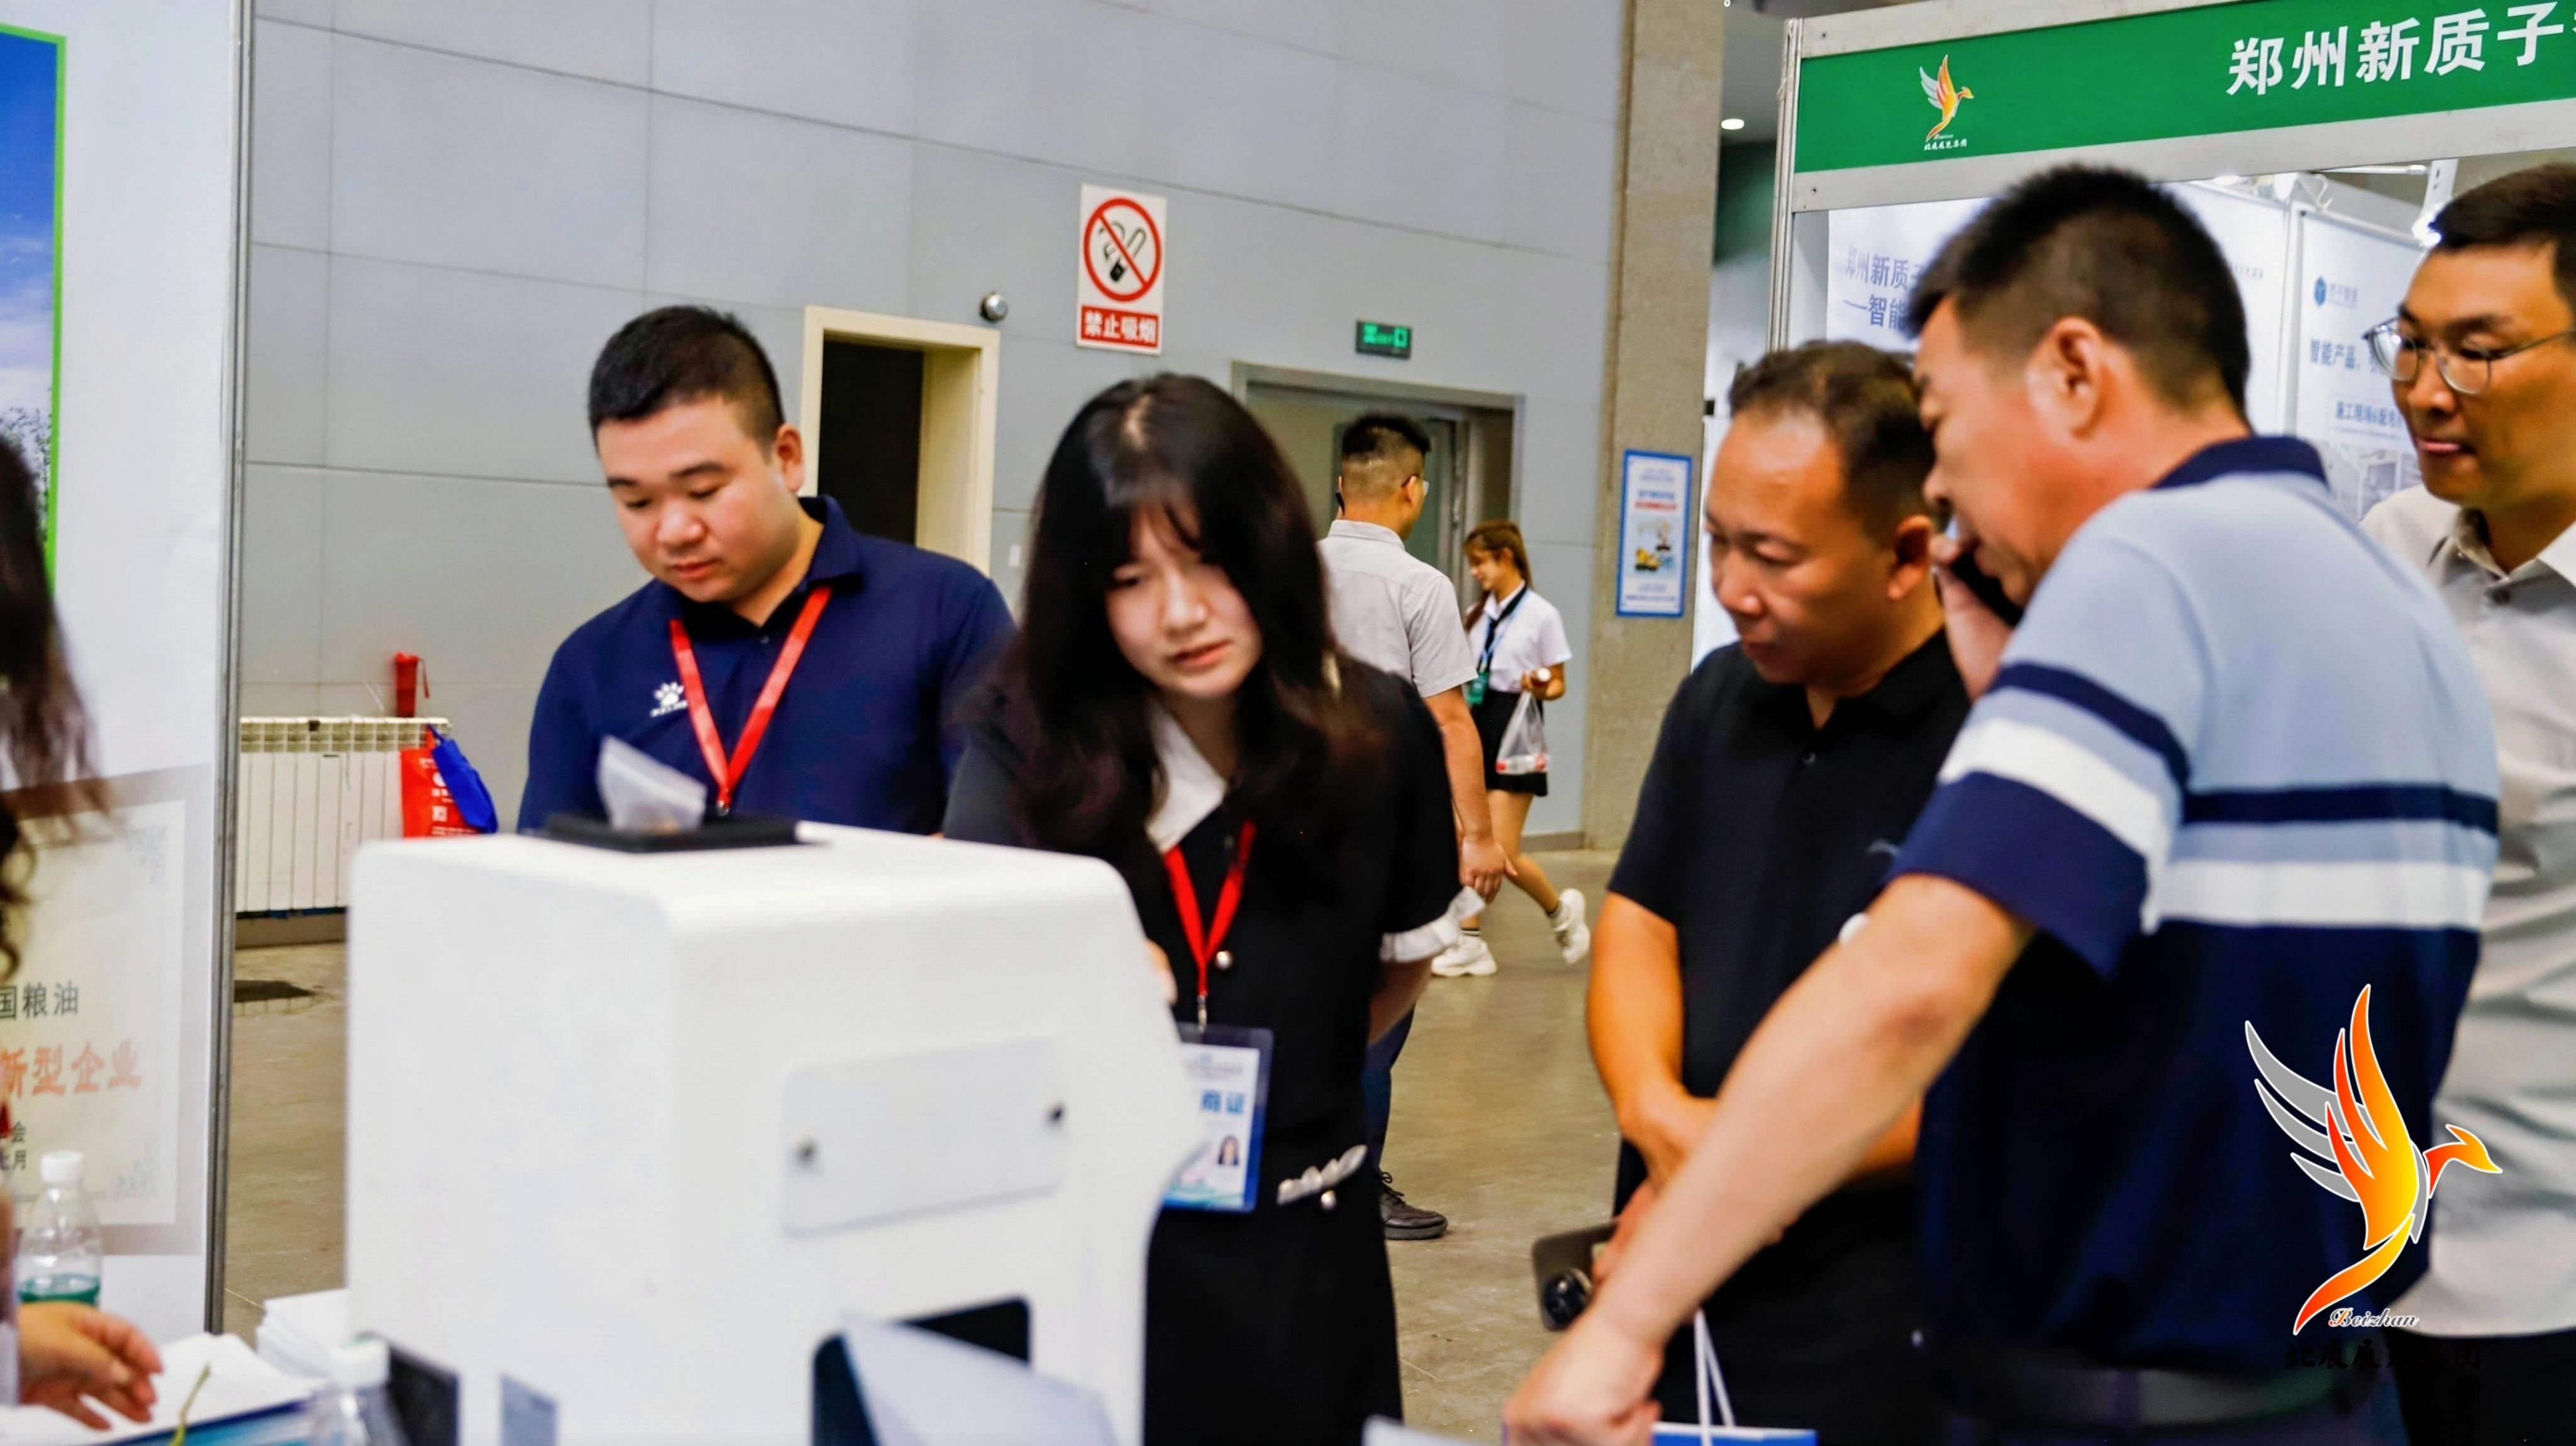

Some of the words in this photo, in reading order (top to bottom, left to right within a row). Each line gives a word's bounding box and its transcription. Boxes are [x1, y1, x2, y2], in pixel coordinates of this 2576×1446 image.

[2226, 1, 2576, 96] 郑州新质子
[1084, 309, 1157, 344] 禁止吸烟
[0, 980, 78, 1020] 国粮油
